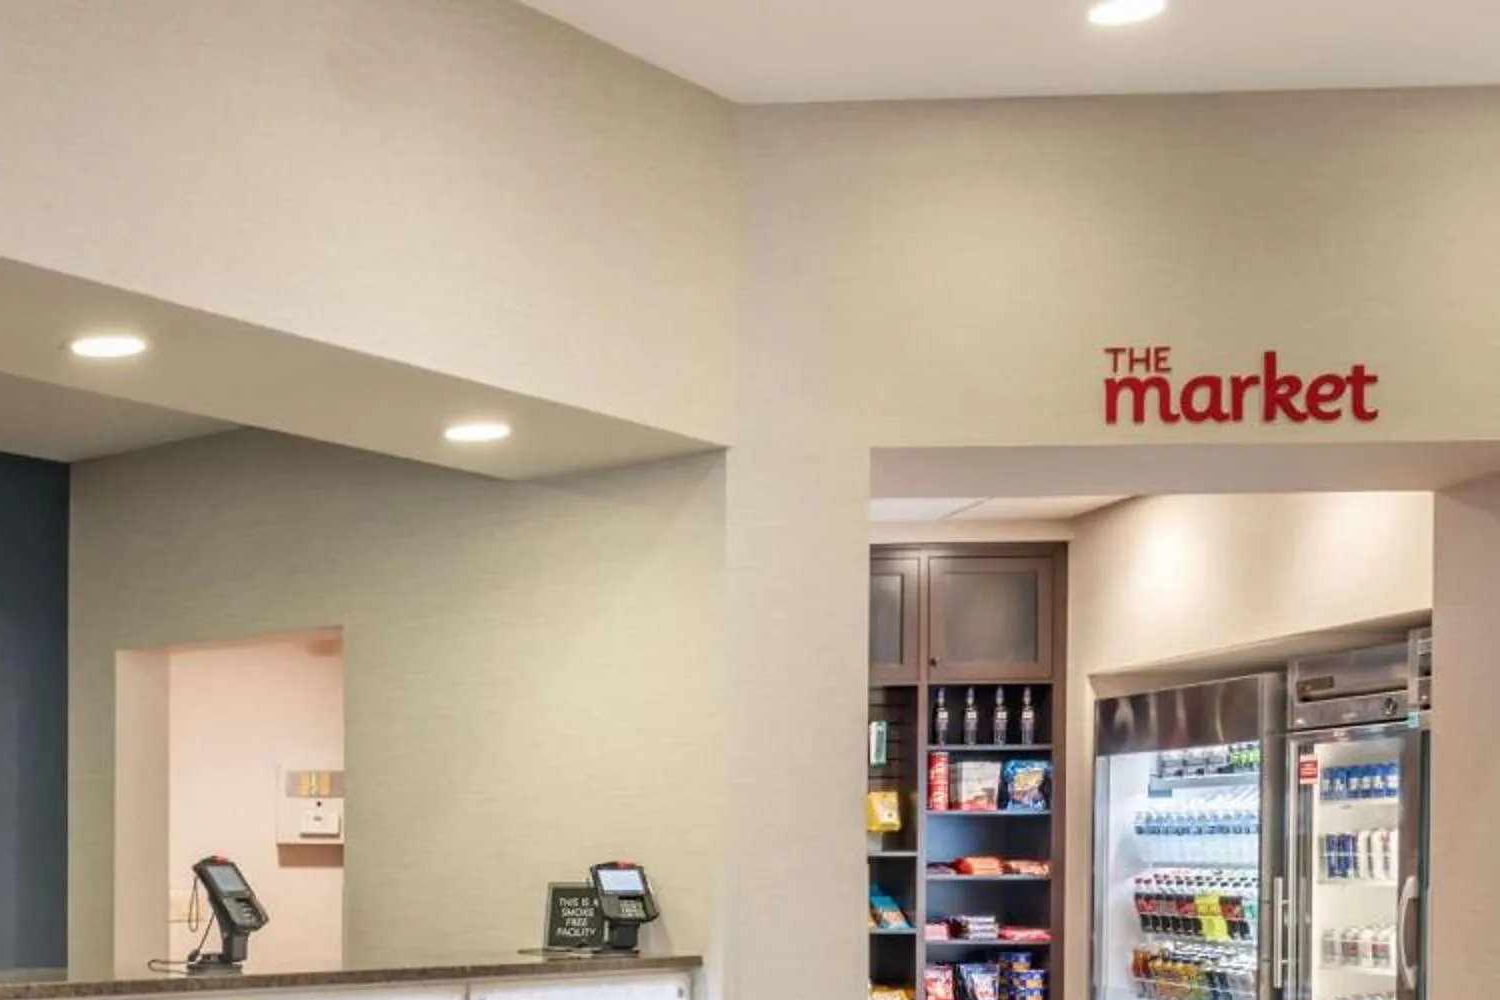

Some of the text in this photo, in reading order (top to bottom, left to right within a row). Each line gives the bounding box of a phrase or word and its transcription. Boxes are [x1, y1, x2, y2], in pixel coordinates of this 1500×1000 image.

[1105, 347, 1171, 373] THE
[1104, 351, 1378, 423] market
[559, 897, 580, 907] THIS
[581, 897, 590, 907] IS
[561, 907, 594, 917] SMOKE
[565, 917, 588, 926] FREE
[557, 927, 596, 937] FACILITY
